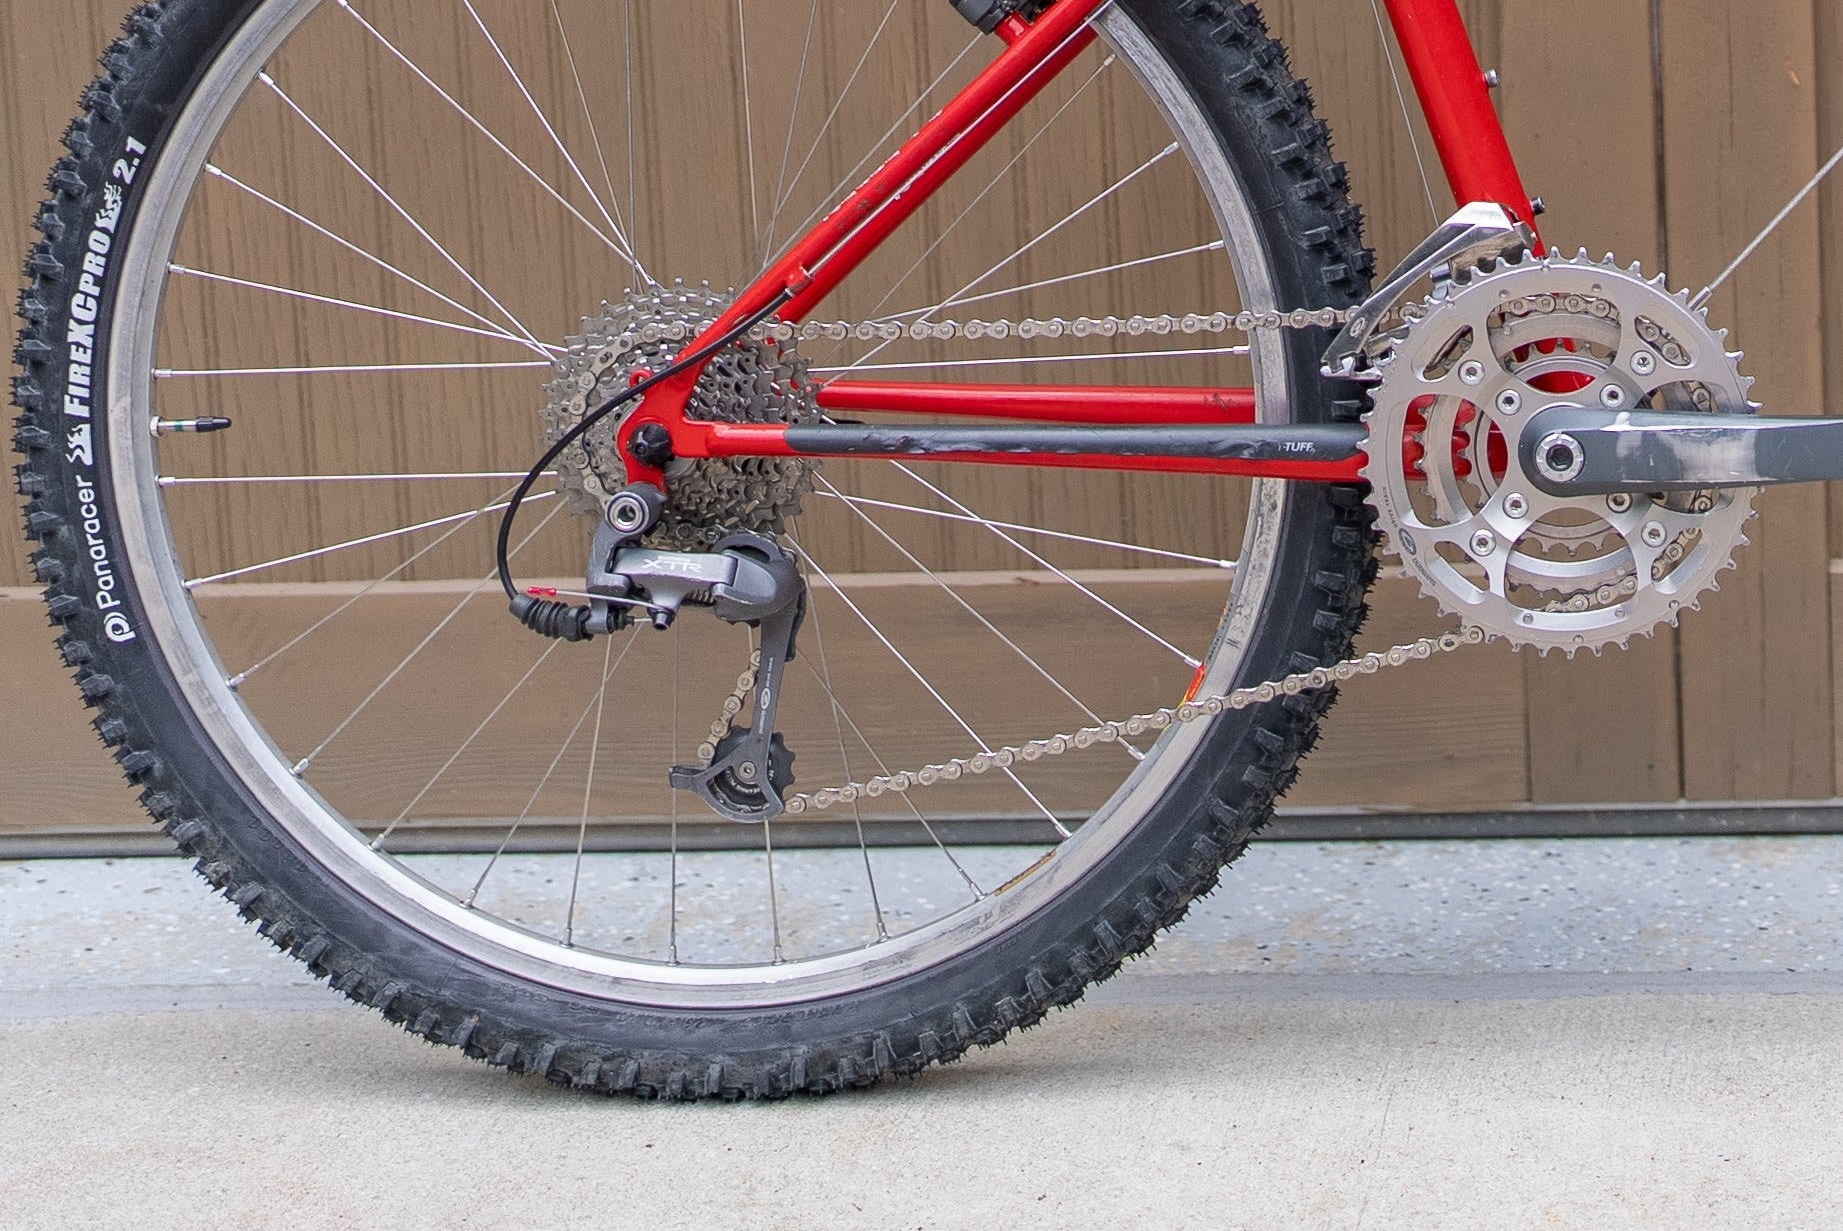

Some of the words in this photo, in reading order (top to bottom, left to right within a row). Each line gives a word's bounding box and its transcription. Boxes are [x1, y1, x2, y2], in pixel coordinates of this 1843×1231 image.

[75, 474, 121, 610] Panaracer
[112, 135, 148, 187] 2.1
[640, 555, 703, 573] XTR
